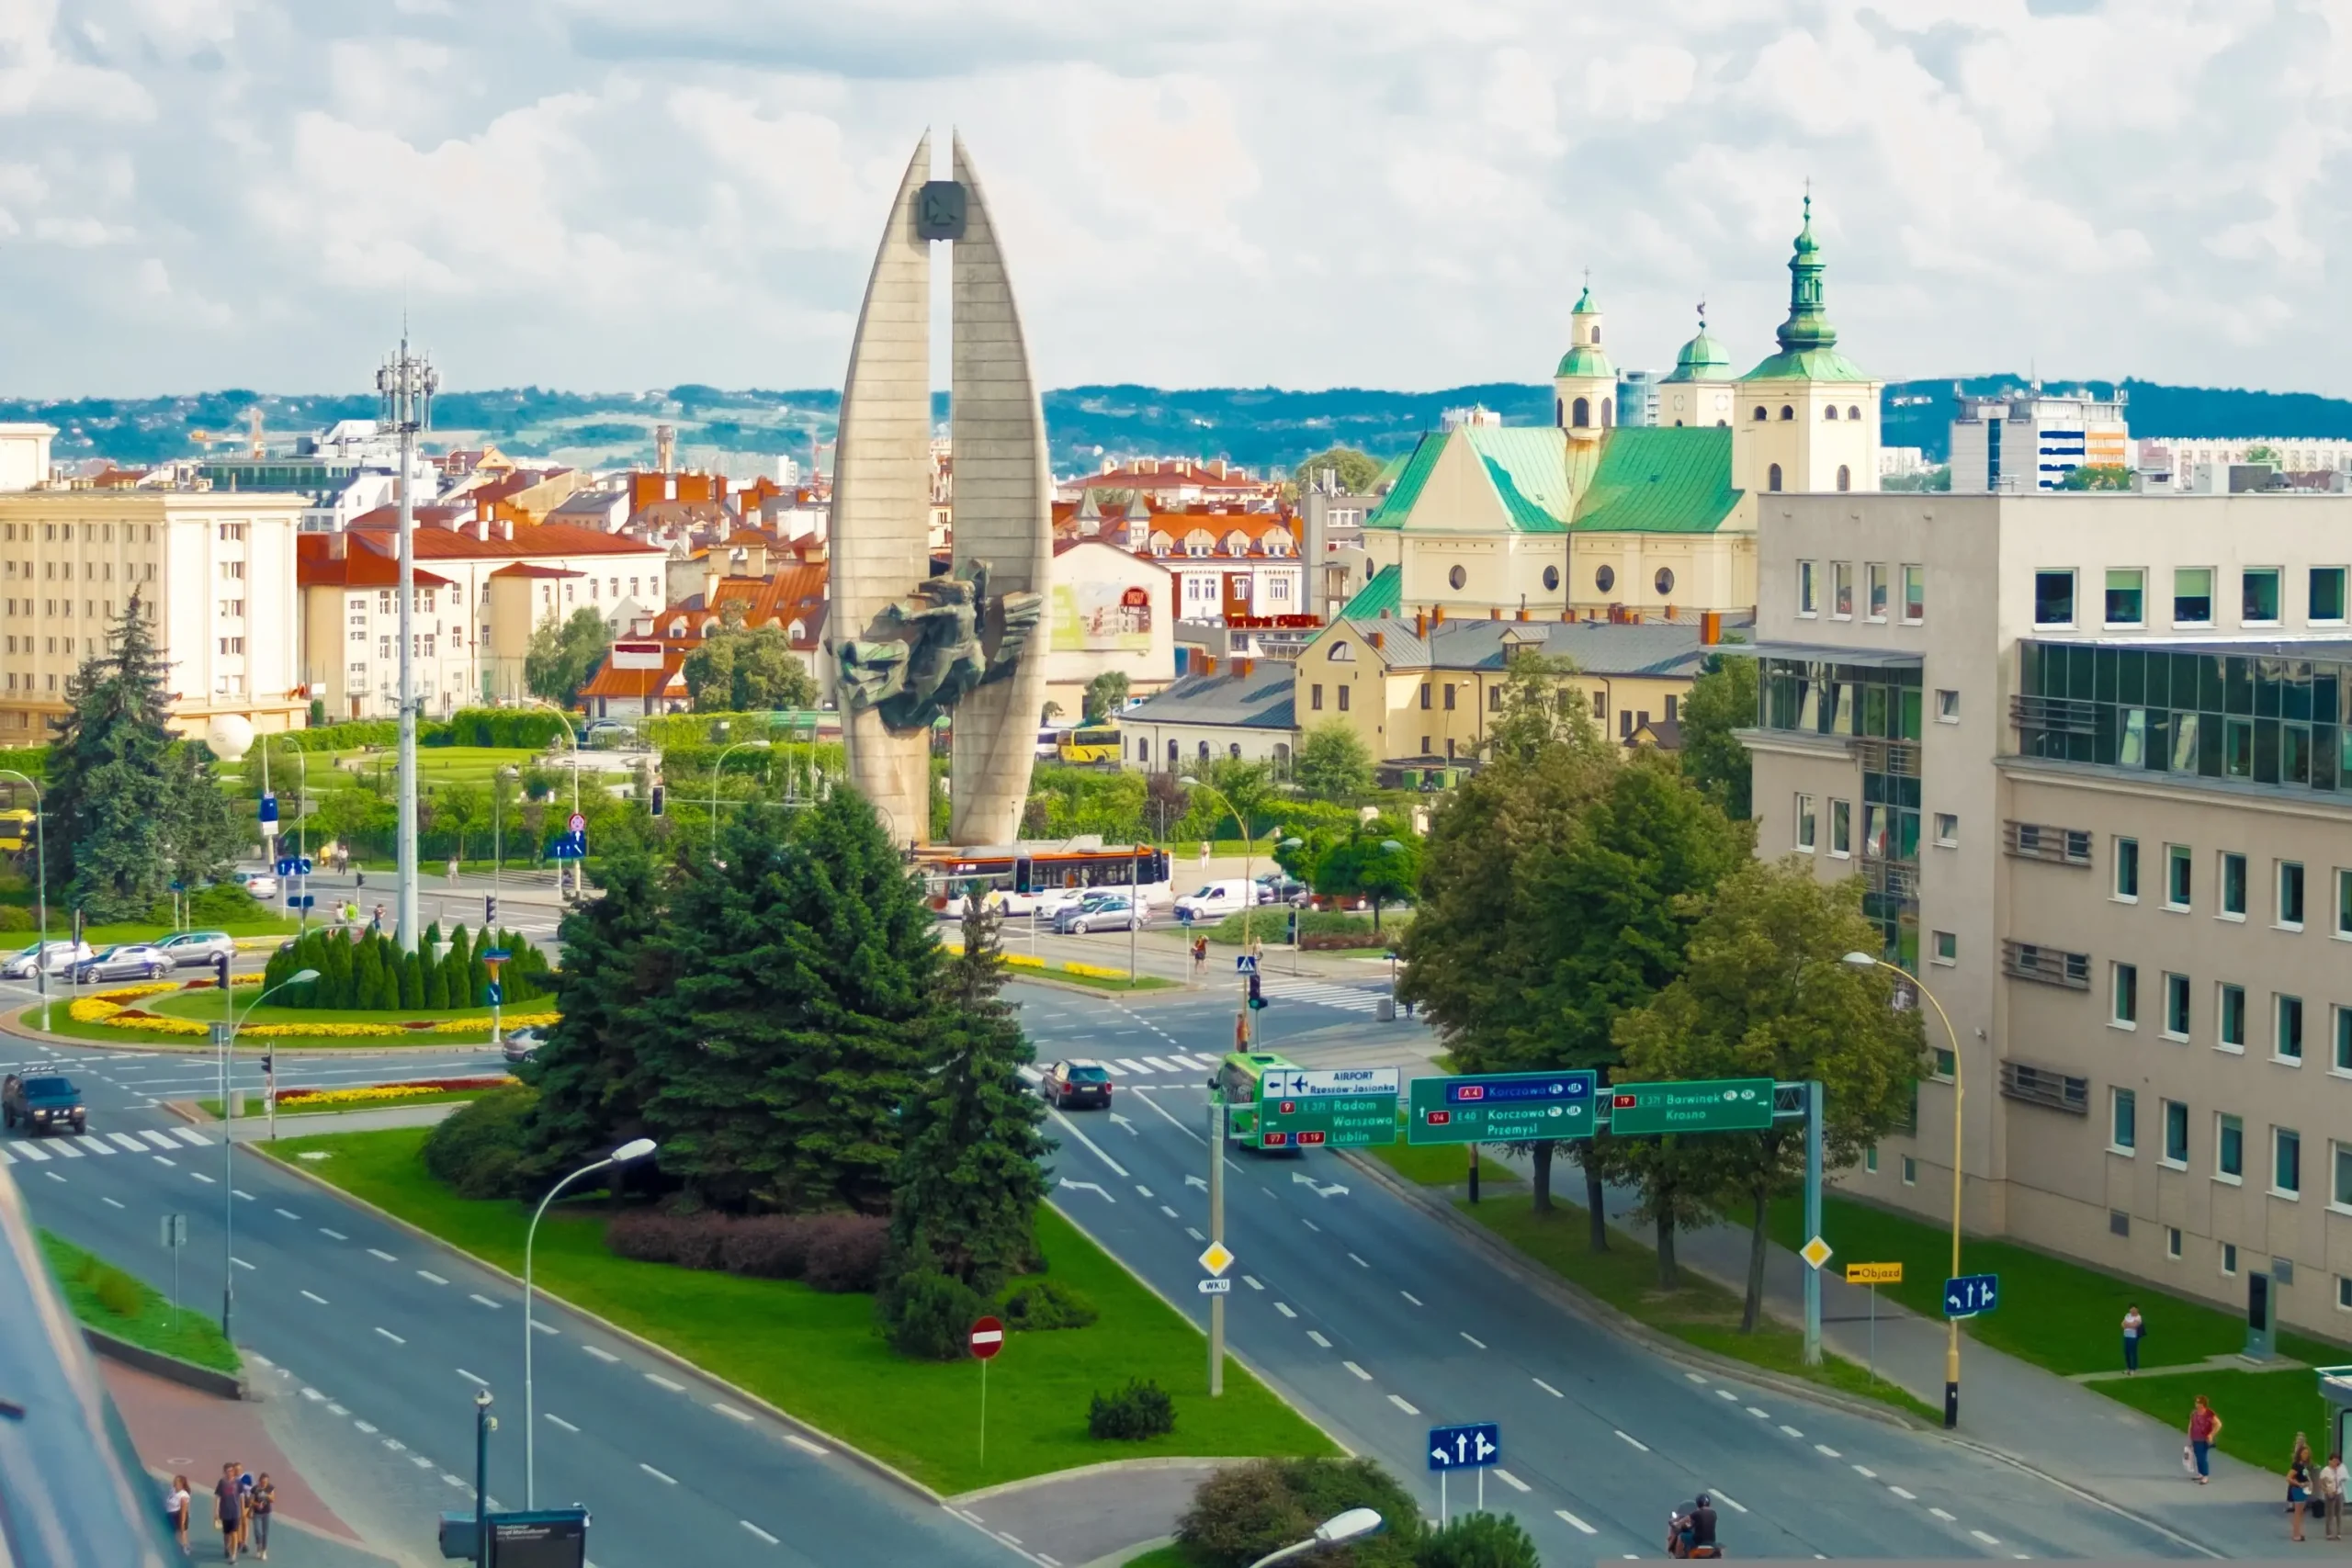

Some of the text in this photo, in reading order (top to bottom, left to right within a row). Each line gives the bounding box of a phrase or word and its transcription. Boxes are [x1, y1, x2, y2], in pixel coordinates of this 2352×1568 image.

[1333, 1071, 1374, 1081] AIRPORT
[1488, 1086, 1546, 1097] Korczowa
[1621, 1097, 1630, 1105] 19
[1667, 1092, 1721, 1105] Barwinek
[1284, 1102, 1291, 1111] 9
[1334, 1100, 1376, 1111] Radom
[1433, 1113, 1444, 1122] 94
[1488, 1110, 1545, 1120] Korczowa
[1666, 1109, 1706, 1121] Krosno
[1333, 1116, 1393, 1127] Warszawa
[1270, 1133, 1281, 1143] 97
[1332, 1131, 1370, 1143] Lublin
[1861, 1268, 1900, 1280] Objazd
[1205, 1281, 1227, 1290] WKU
